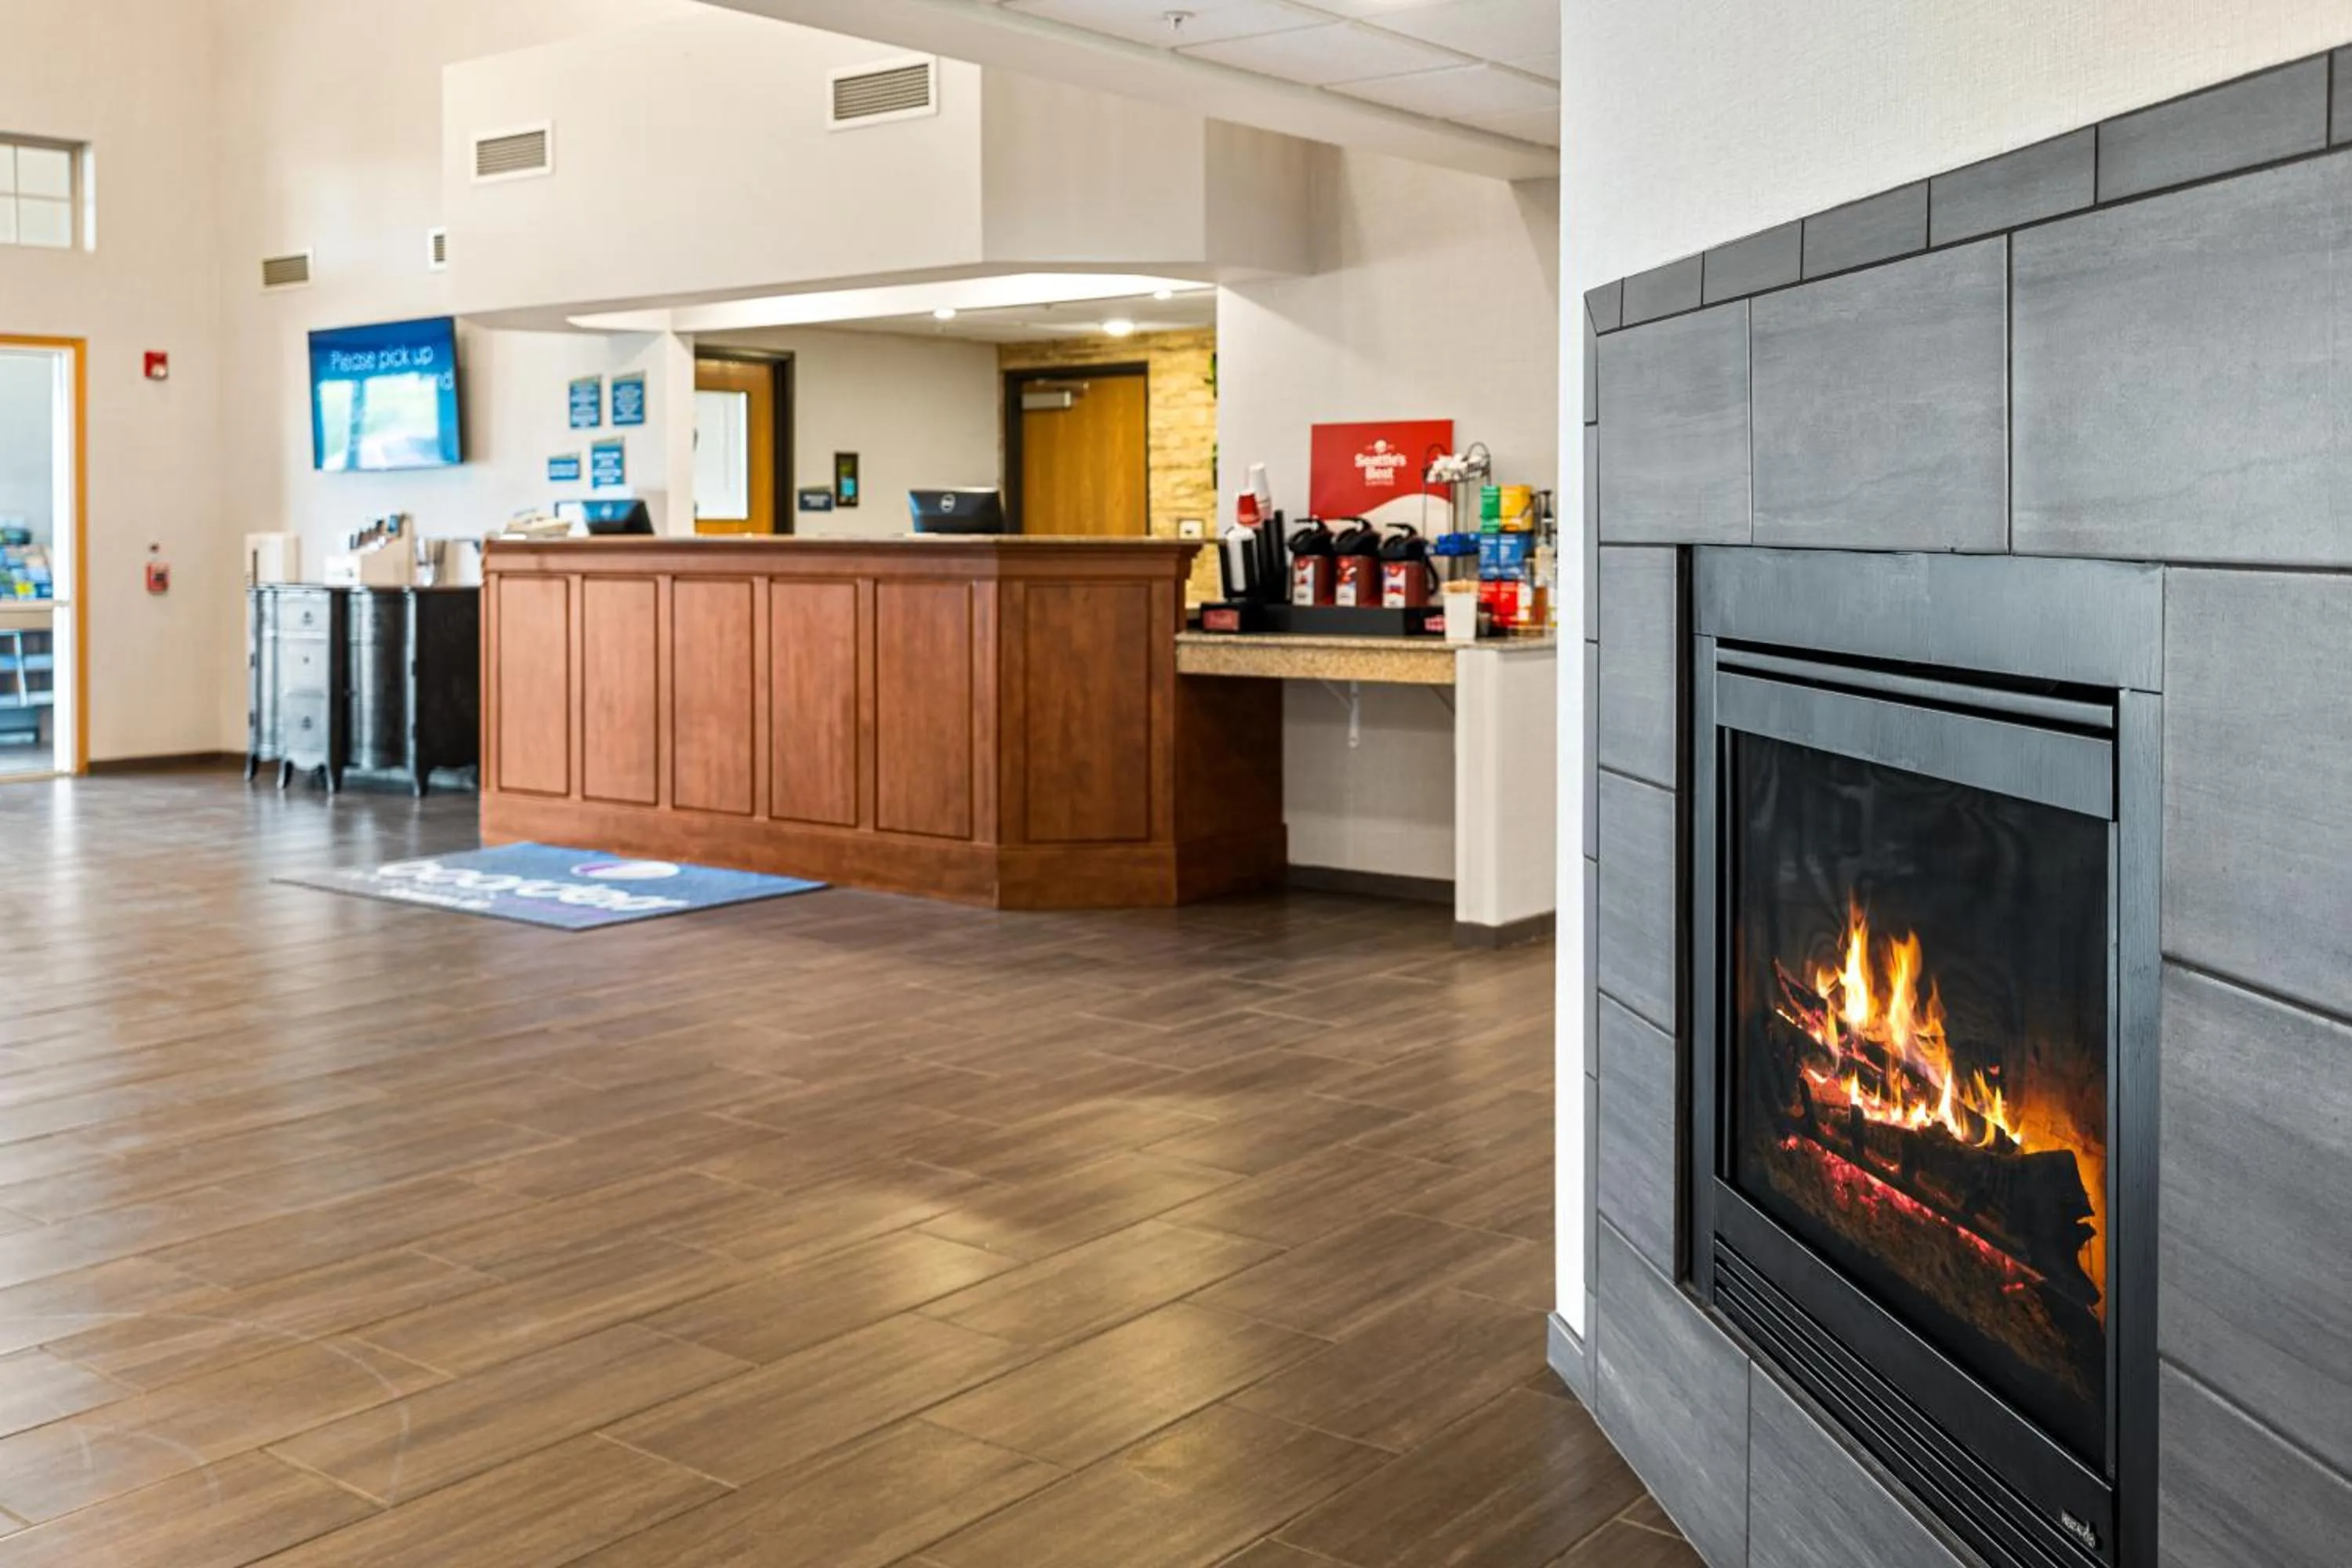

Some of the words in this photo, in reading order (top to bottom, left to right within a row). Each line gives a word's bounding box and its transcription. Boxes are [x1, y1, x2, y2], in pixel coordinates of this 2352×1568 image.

[330, 350, 376, 372] Please
[379, 345, 409, 370] pick
[413, 345, 434, 365] up
